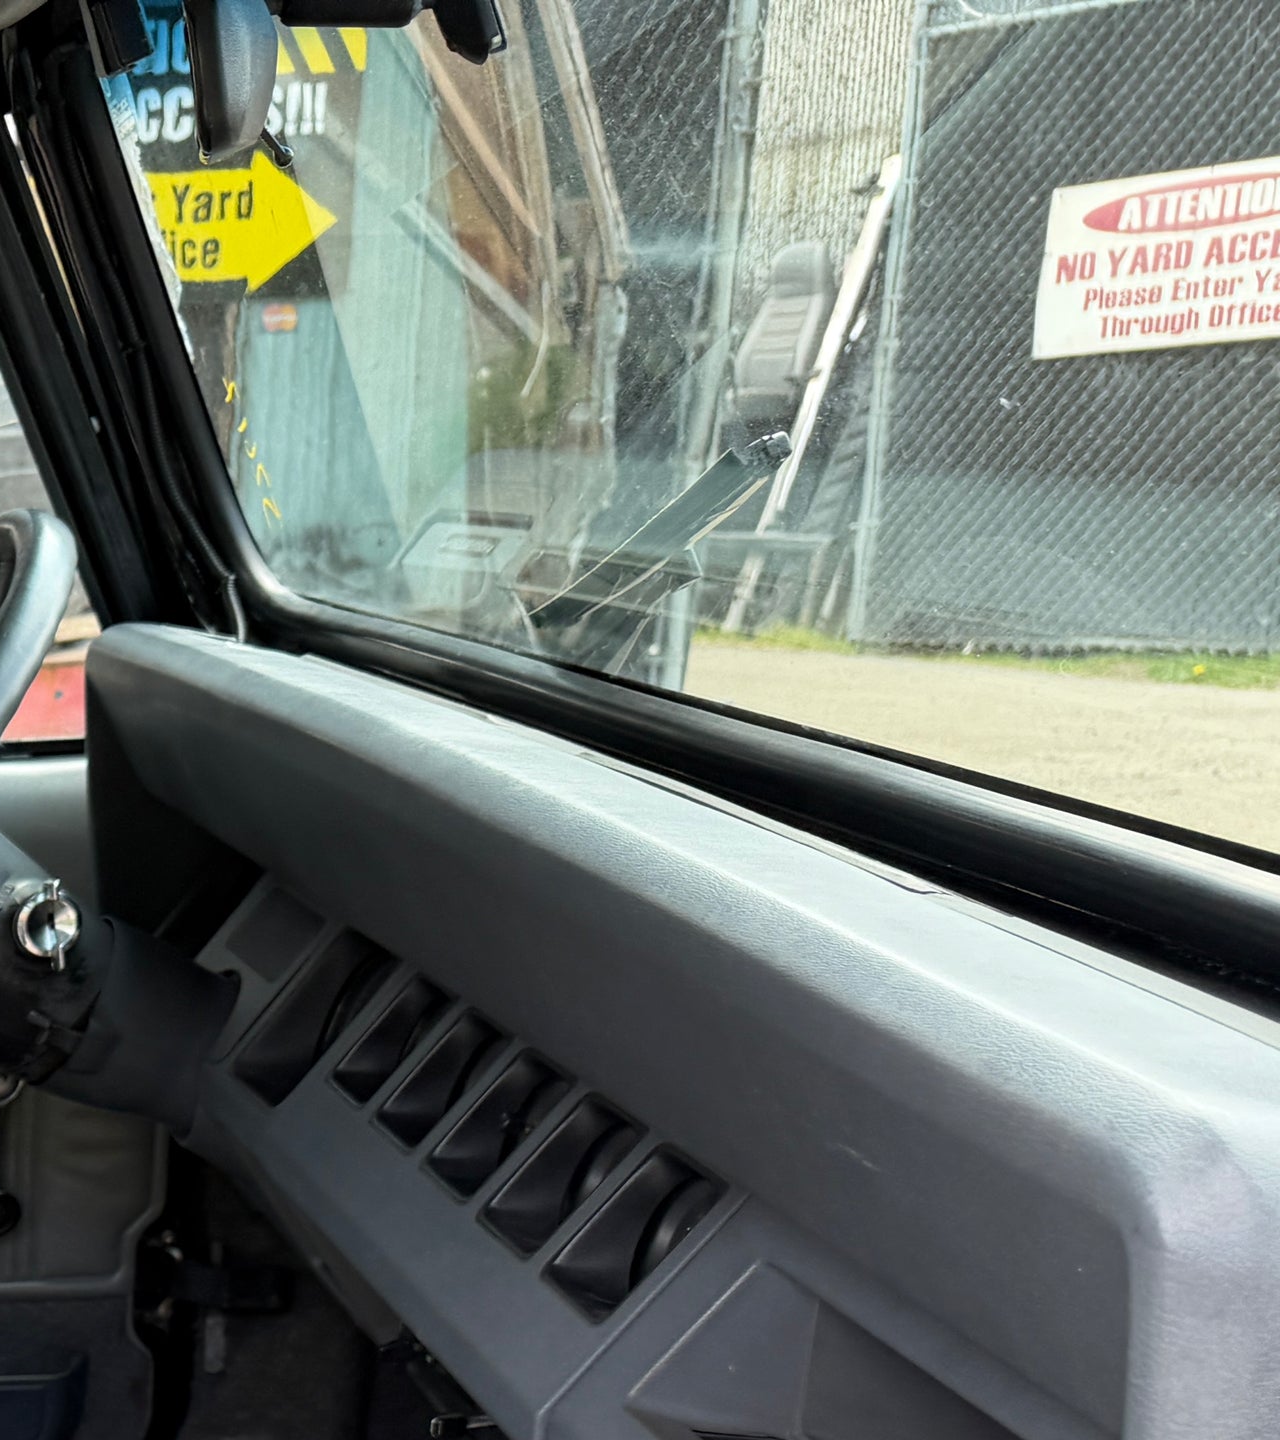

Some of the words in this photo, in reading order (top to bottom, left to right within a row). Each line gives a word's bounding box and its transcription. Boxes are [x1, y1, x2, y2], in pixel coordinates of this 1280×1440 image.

[172, 180, 254, 224] Yard
[1117, 178, 1280, 231] ATTENTIO
[1056, 251, 1096, 284] NO
[1108, 239, 1194, 278] YARD
[1083, 285, 1162, 311] Please
[1172, 276, 1244, 301] Enter
[1100, 308, 1200, 339] Through
